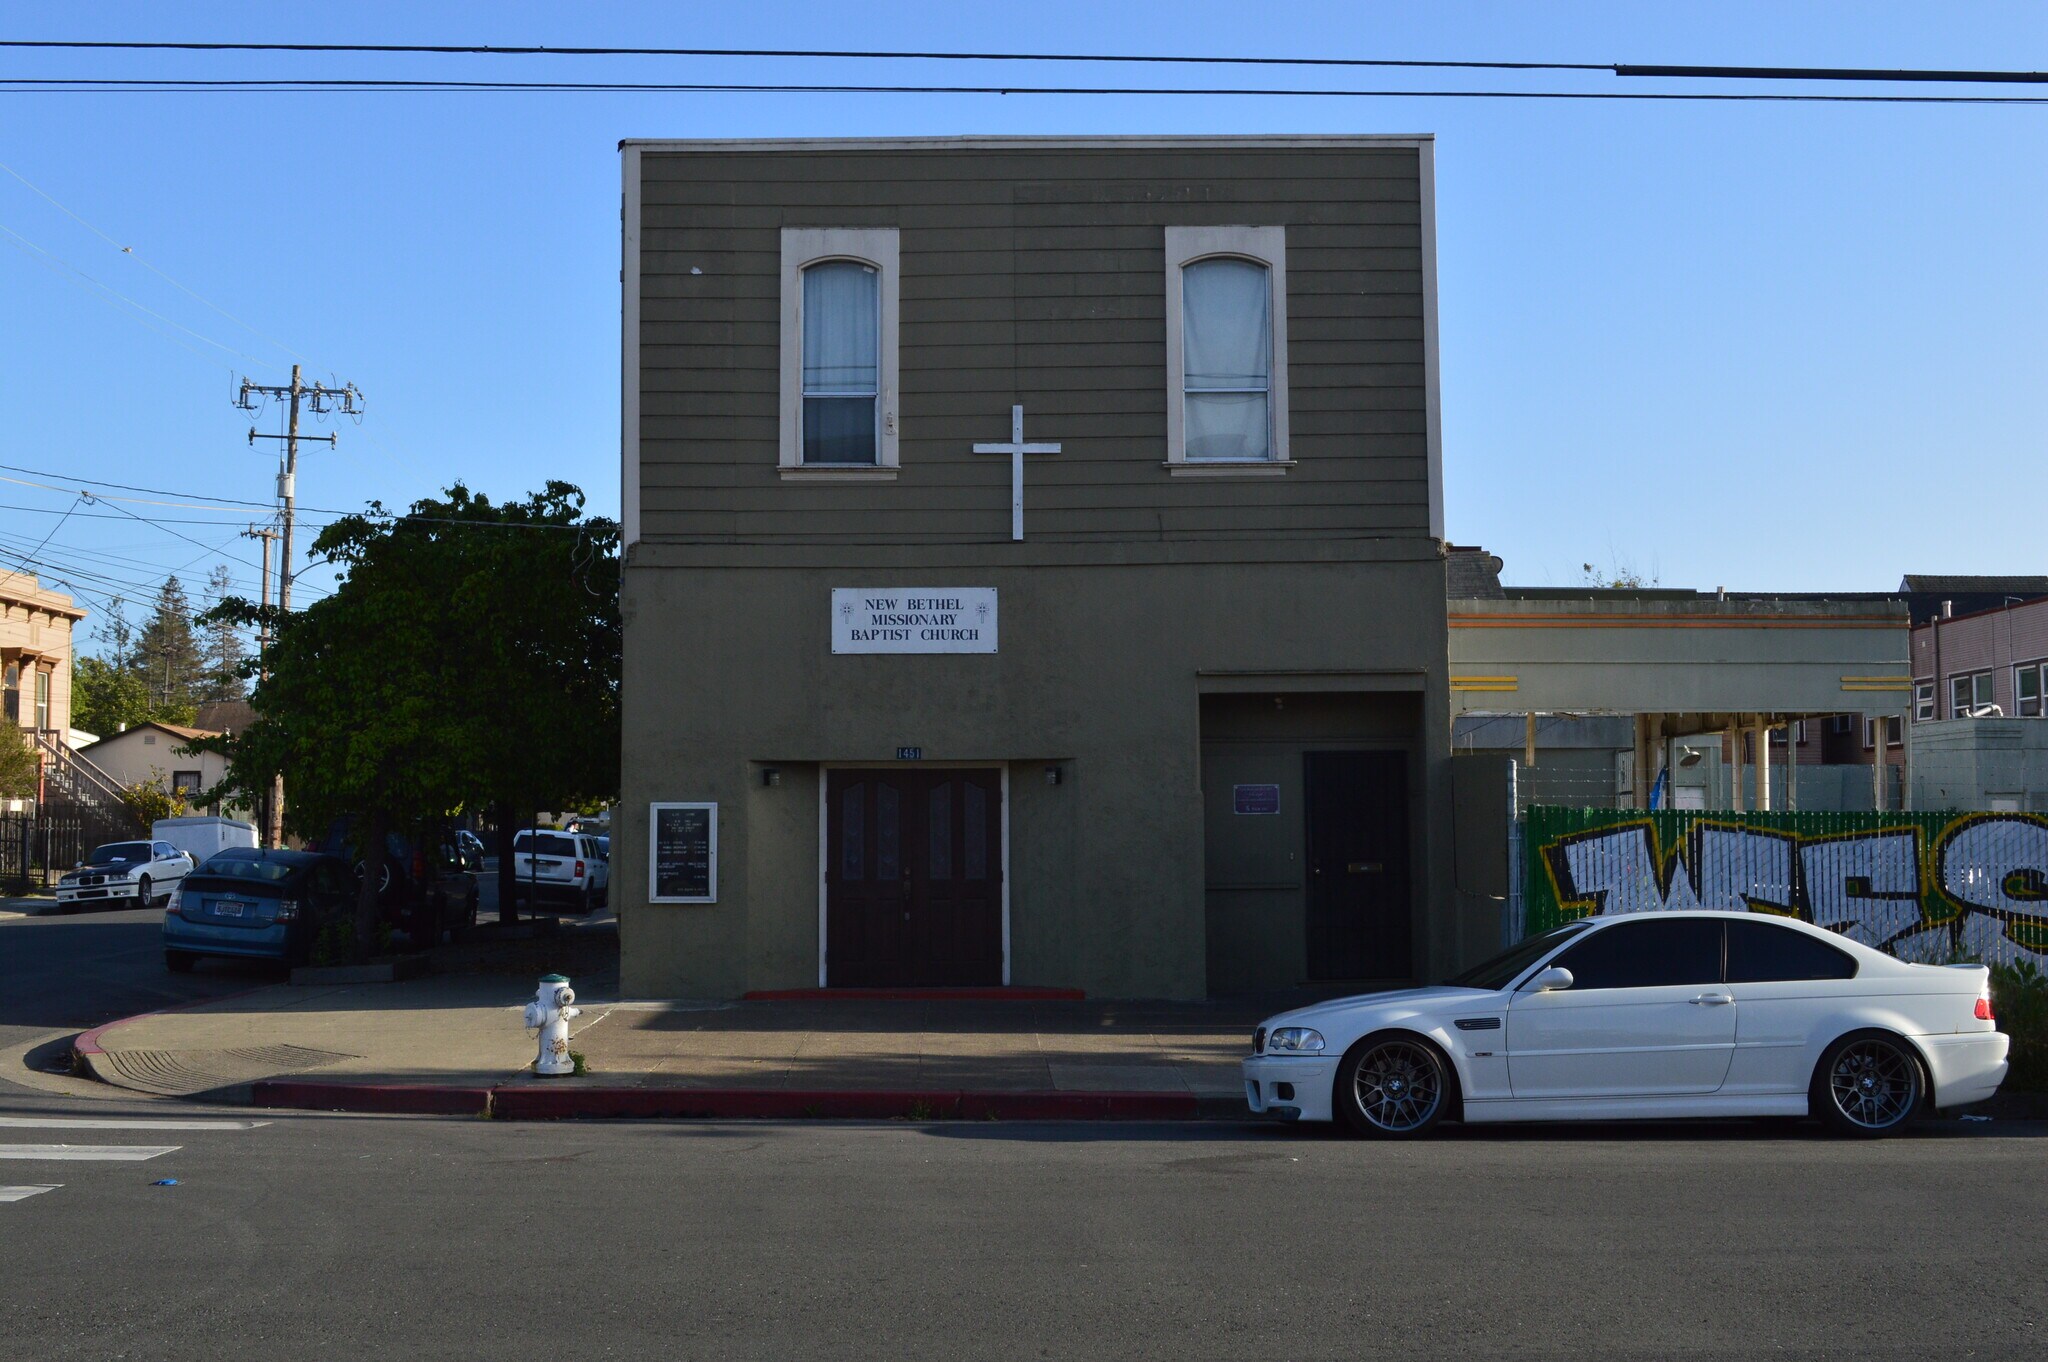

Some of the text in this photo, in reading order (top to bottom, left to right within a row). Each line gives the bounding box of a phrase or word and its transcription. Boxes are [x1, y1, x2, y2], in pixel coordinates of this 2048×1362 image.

[865, 598, 964, 610] NEW BETHEL
[871, 613, 957, 625] MISSIONARY
[851, 629, 979, 641] BAPTIST CHURCH
[898, 748, 919, 758] 1451
